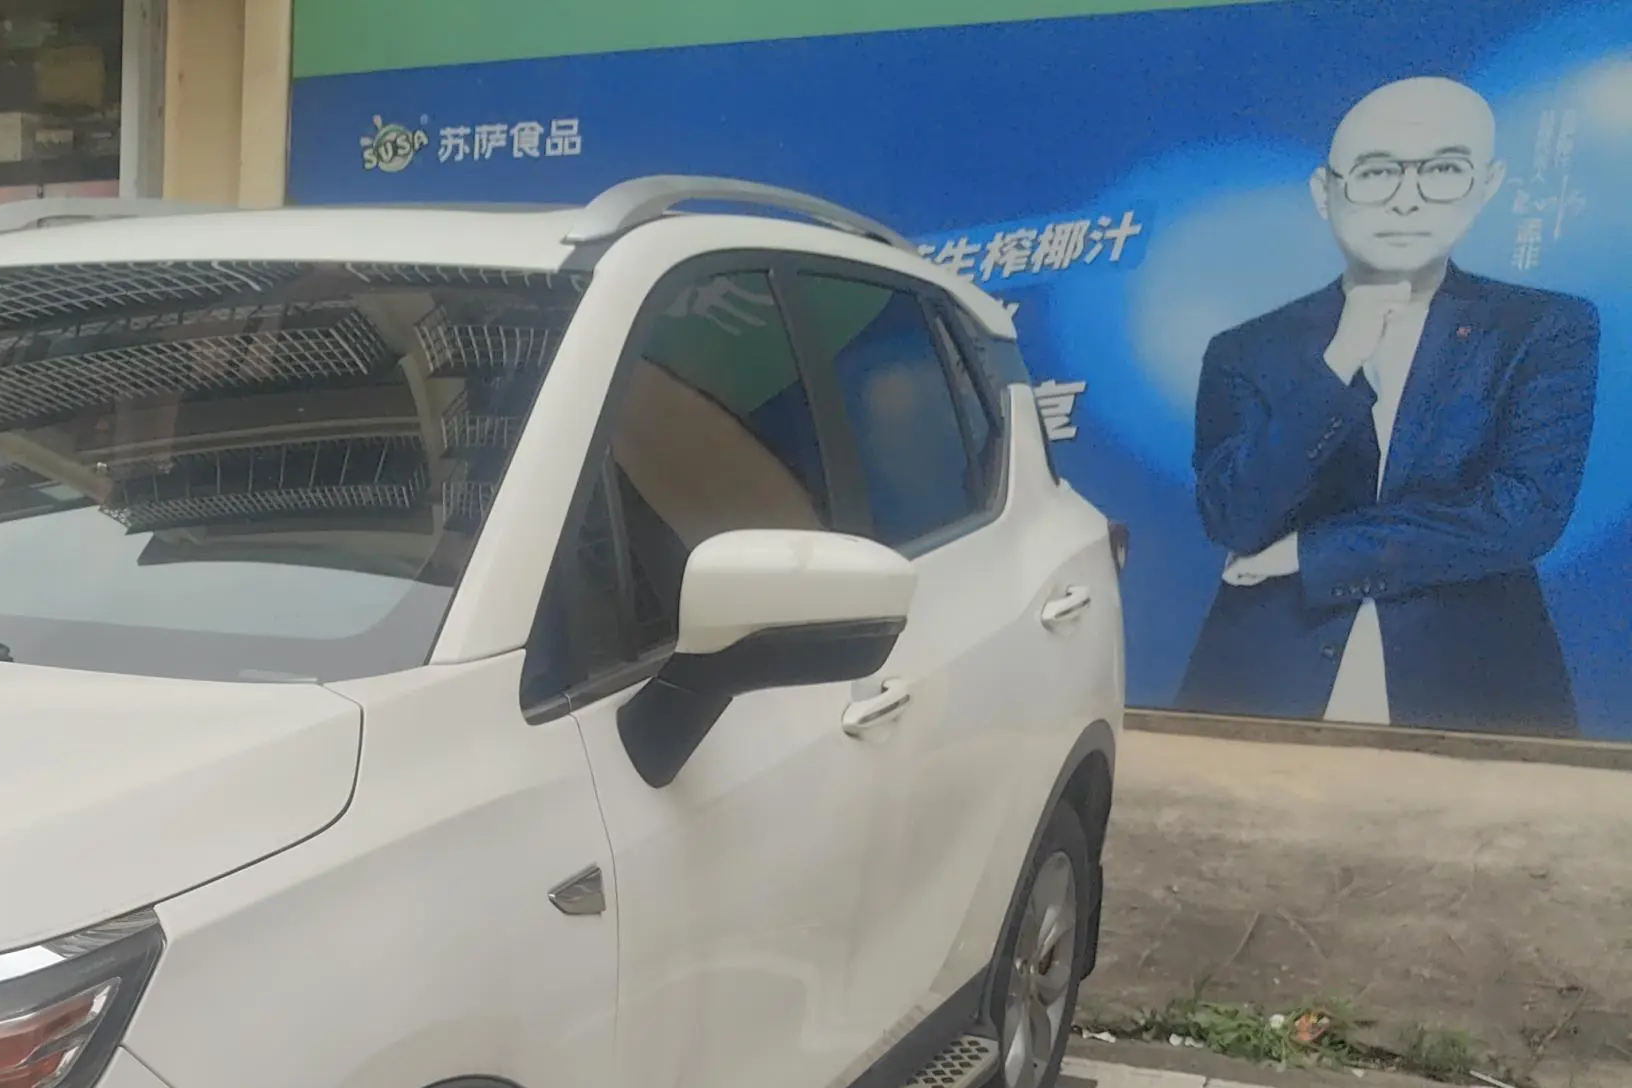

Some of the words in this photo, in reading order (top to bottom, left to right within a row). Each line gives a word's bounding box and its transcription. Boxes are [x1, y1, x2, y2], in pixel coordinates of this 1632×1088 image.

[363, 130, 428, 170] SUSA
[438, 118, 582, 164] 苏萨食品
[917, 211, 1143, 281] 生榨椰汁
